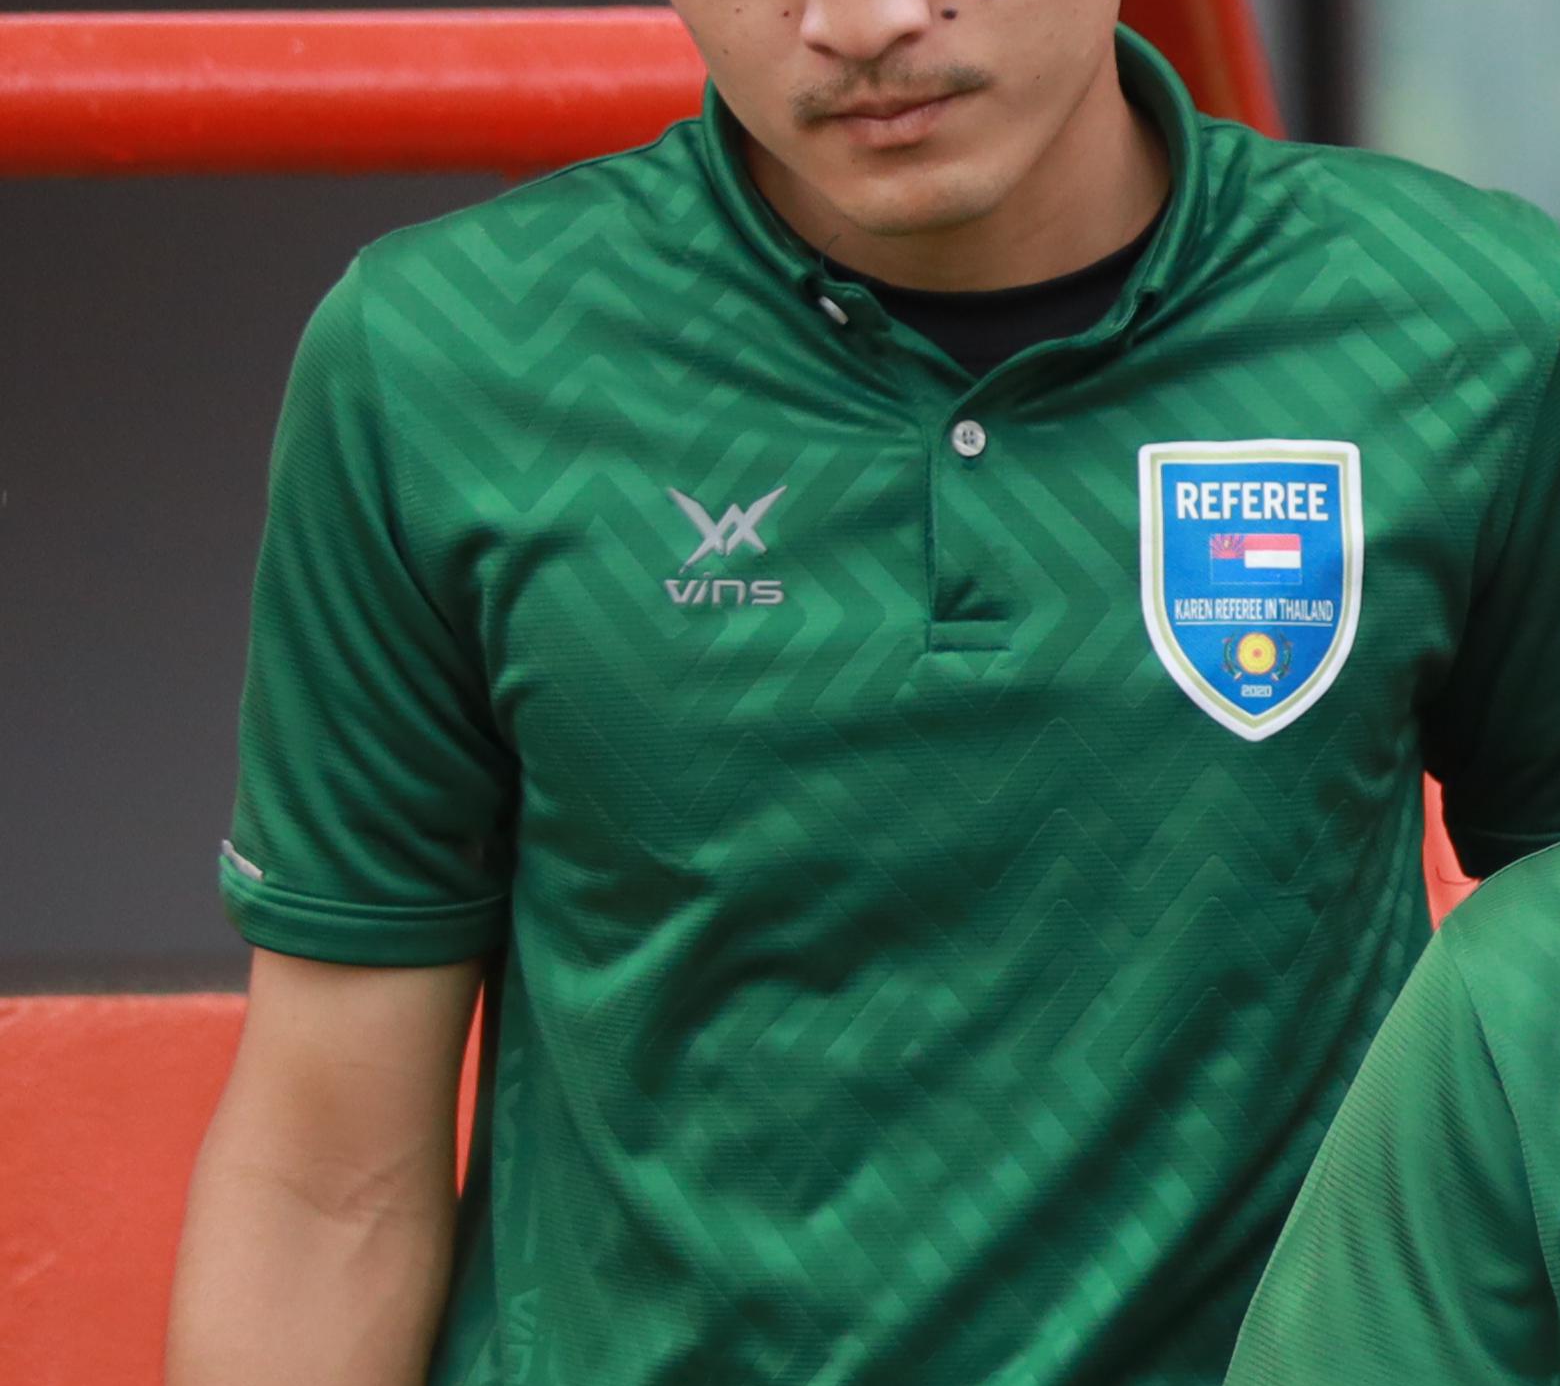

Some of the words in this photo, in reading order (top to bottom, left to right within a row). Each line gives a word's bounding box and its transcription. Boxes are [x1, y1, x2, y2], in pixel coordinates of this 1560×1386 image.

[1176, 481, 1329, 521] REFEREE
[1174, 598, 1212, 620] KAREN
[1215, 598, 1263, 620] REFEREE
[1264, 598, 1277, 620] IN
[1279, 598, 1334, 622] THAILAND
[1241, 684, 1272, 697] 2020
